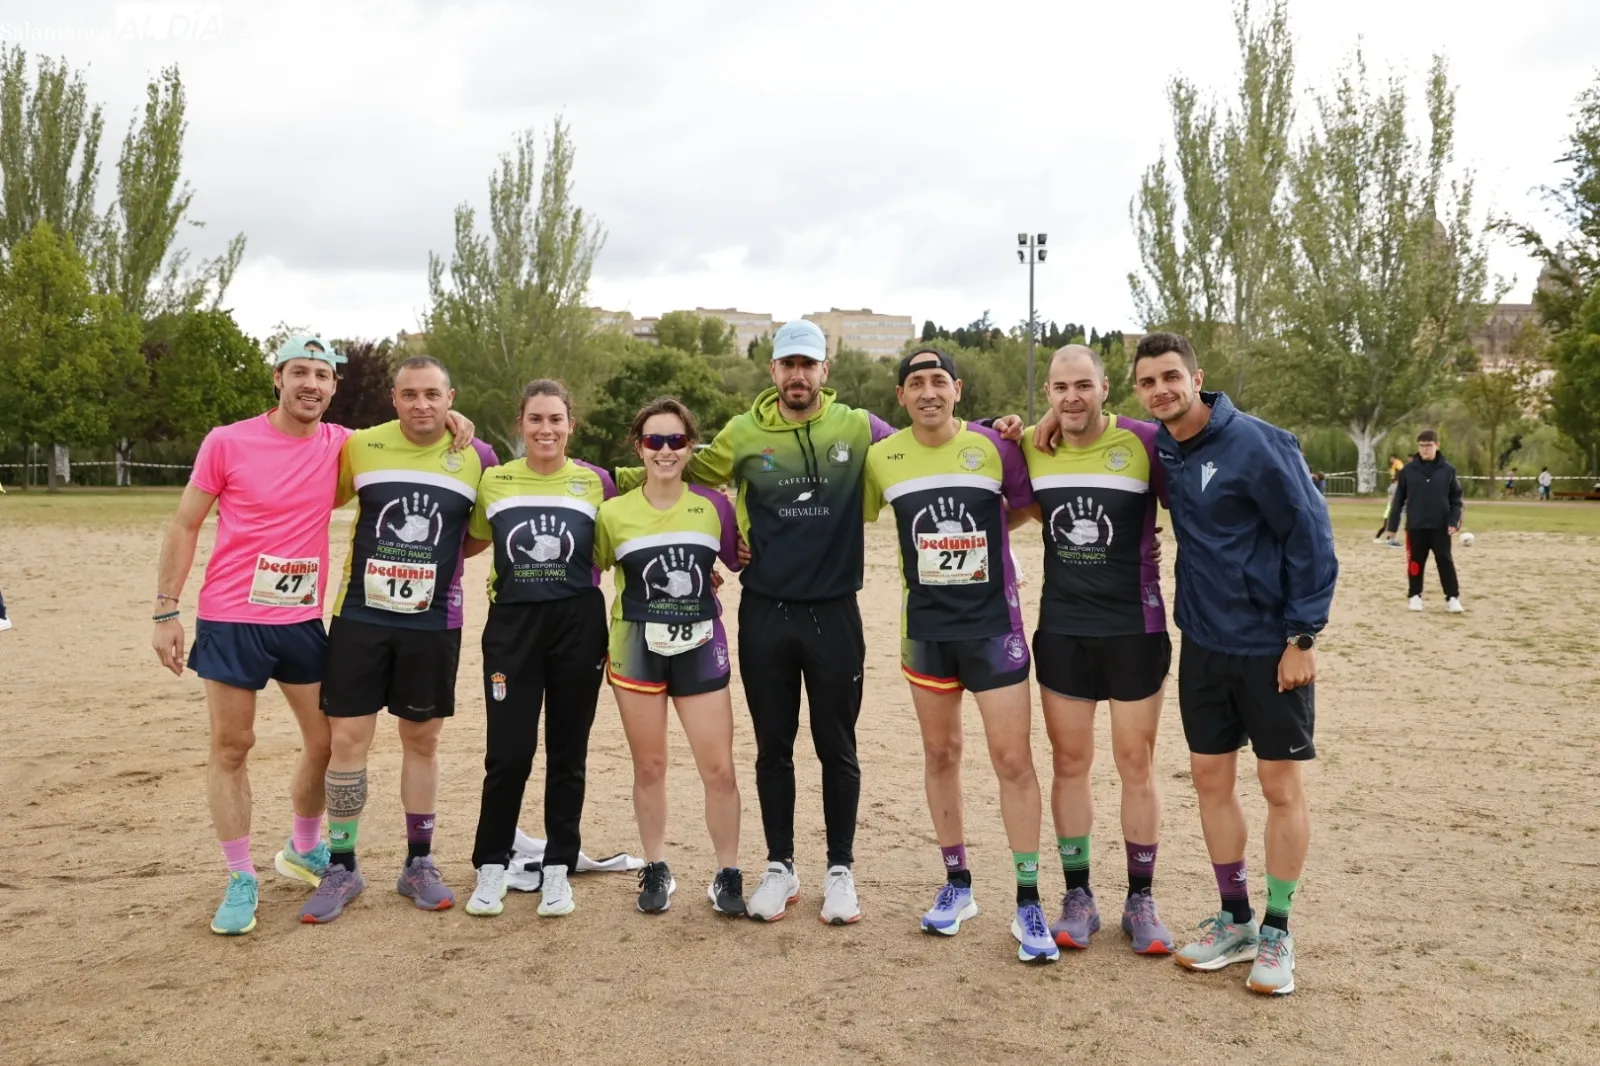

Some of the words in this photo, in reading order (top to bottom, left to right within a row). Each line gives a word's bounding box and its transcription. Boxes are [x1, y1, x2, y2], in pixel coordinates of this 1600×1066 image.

[778, 507, 830, 517] CHEVALIER
[396, 543, 433, 551] DEPORTIVO
[919, 535, 986, 549] bedunia
[377, 545, 406, 556] ROBERTO
[408, 550, 432, 560] RAMOS
[939, 550, 967, 570] 27
[258, 557, 318, 574] bedunia
[366, 561, 434, 579] bedunia
[514, 569, 543, 578] ROBERTO
[544, 569, 566, 577] RAMOS
[275, 575, 304, 593] 47
[386, 578, 413, 599] 16
[667, 624, 693, 641] 98
